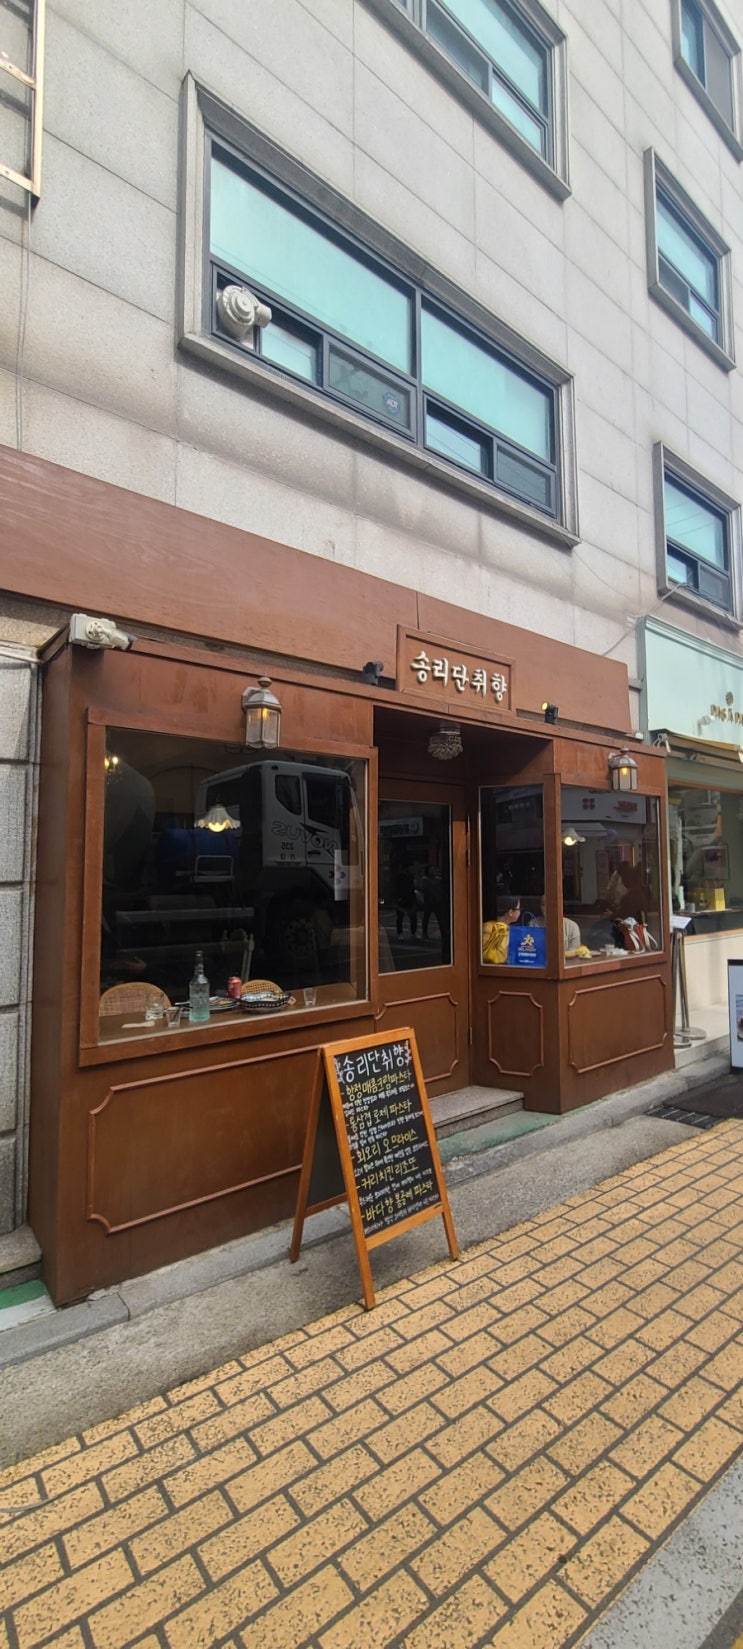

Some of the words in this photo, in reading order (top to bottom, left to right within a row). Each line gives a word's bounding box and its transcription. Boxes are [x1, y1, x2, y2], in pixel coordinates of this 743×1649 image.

[410, 650, 507, 701] 송리단취향
[343, 1043, 404, 1083] 송리단취향
[389, 1099, 413, 1116] 파스타
[413, 1179, 434, 1197] 파스타
